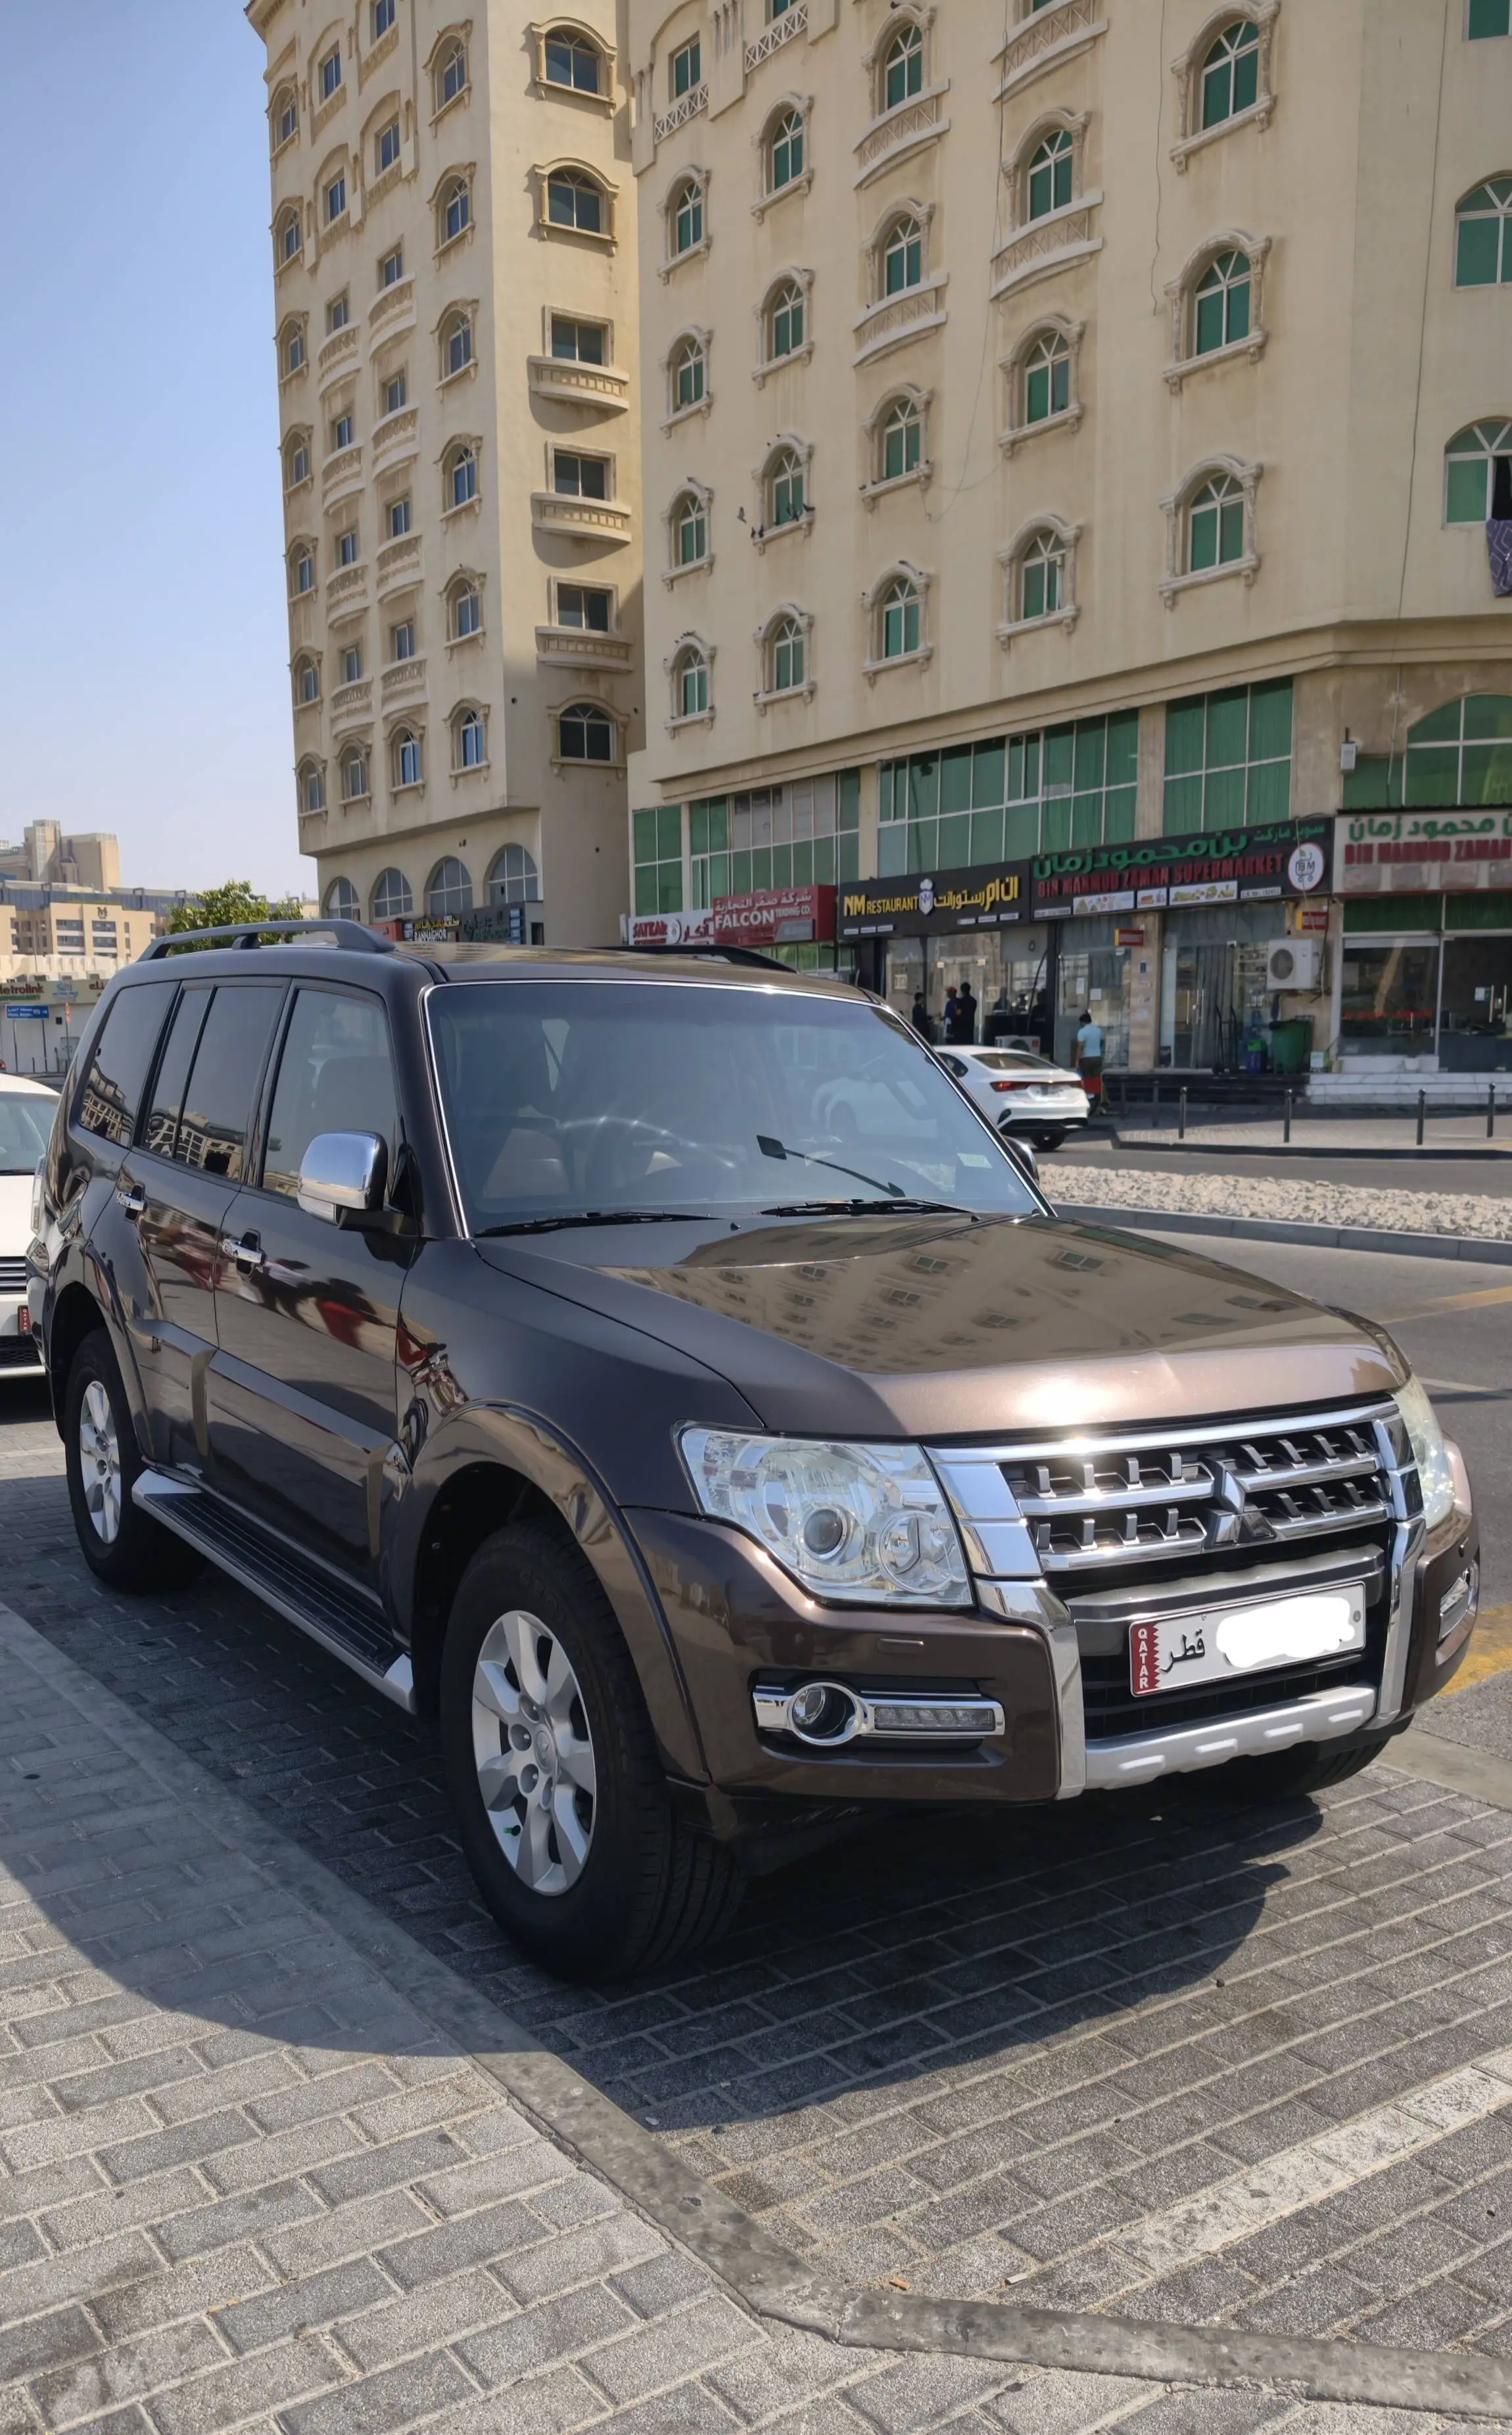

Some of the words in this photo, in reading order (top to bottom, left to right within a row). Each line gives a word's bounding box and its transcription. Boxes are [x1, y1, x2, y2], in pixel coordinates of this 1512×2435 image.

[1350, 816, 1402, 842] زمان
[1407, 817, 1496, 839] محمود
[1093, 840, 1208, 871] محمود
[1210, 832, 1247, 859] بن
[1033, 849, 1093, 880] زمان
[1174, 853, 1284, 884] SUPERMARKET
[715, 897, 752, 914] التجارية
[753, 895, 778, 910] صقر
[781, 889, 811, 905] شركة
[843, 894, 866, 917] NM
[866, 895, 918, 914] RESTAURANT
[715, 909, 774, 930] FALCON
[1138, 1628, 1148, 1689] QATAR
[1159, 1628, 1205, 1673] قطر
